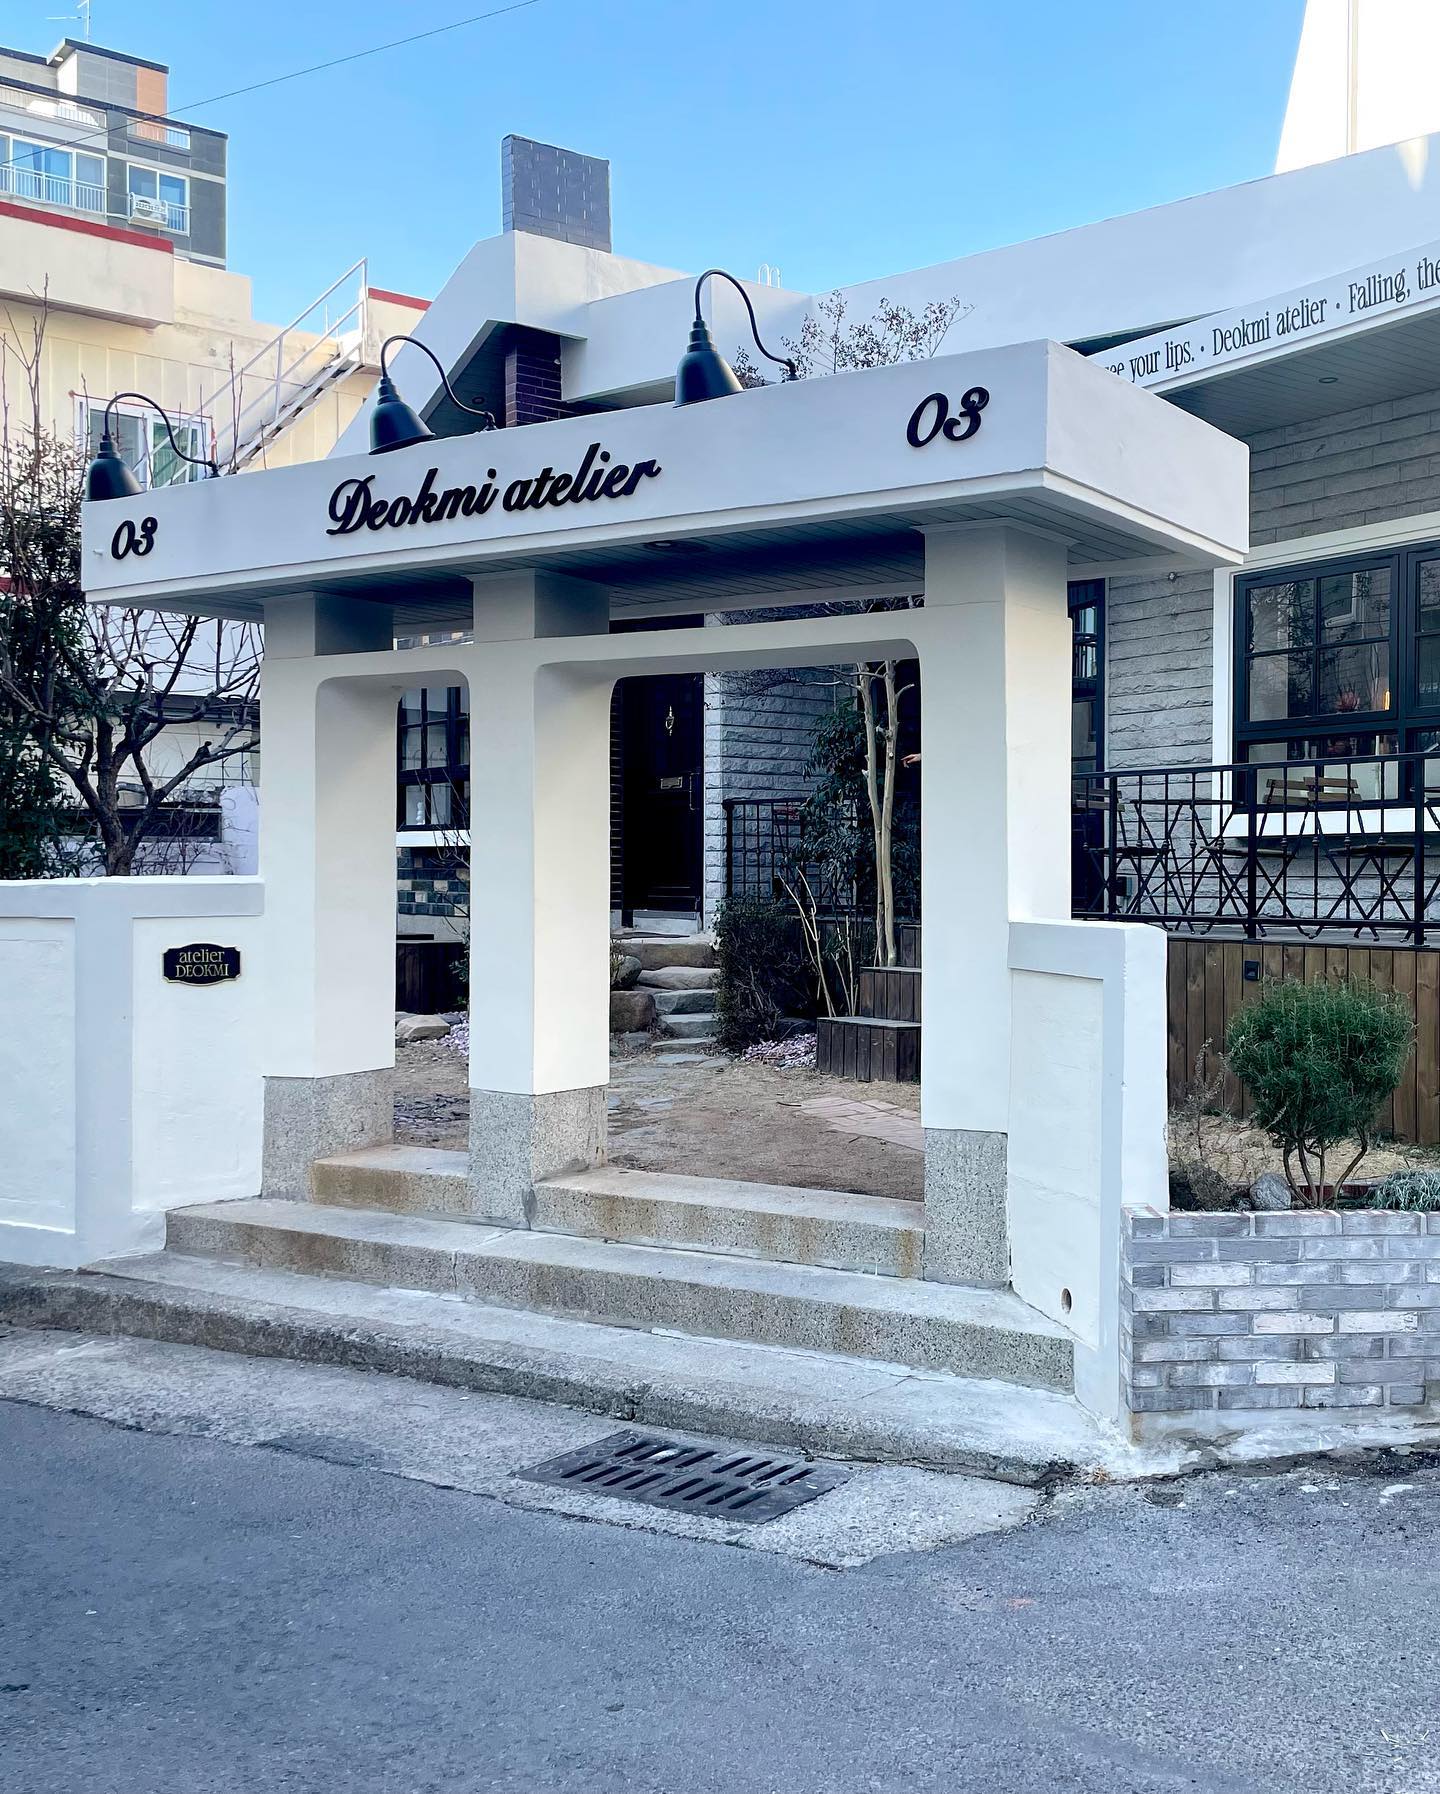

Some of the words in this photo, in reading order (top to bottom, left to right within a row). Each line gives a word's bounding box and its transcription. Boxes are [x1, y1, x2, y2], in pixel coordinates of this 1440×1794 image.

[1128, 350, 1160, 383] your
[1165, 340, 1195, 372] lips.
[1212, 312, 1271, 356] Deokmi
[1275, 298, 1328, 337] atelier
[1347, 267, 1411, 314] Falling,
[906, 386, 990, 448] 03
[326, 467, 499, 536] Deokmi
[502, 442, 661, 512] atelier
[111, 517, 158, 560] 03
[175, 963, 229, 977] DEOKMI
[179, 949, 225, 963] atelier
